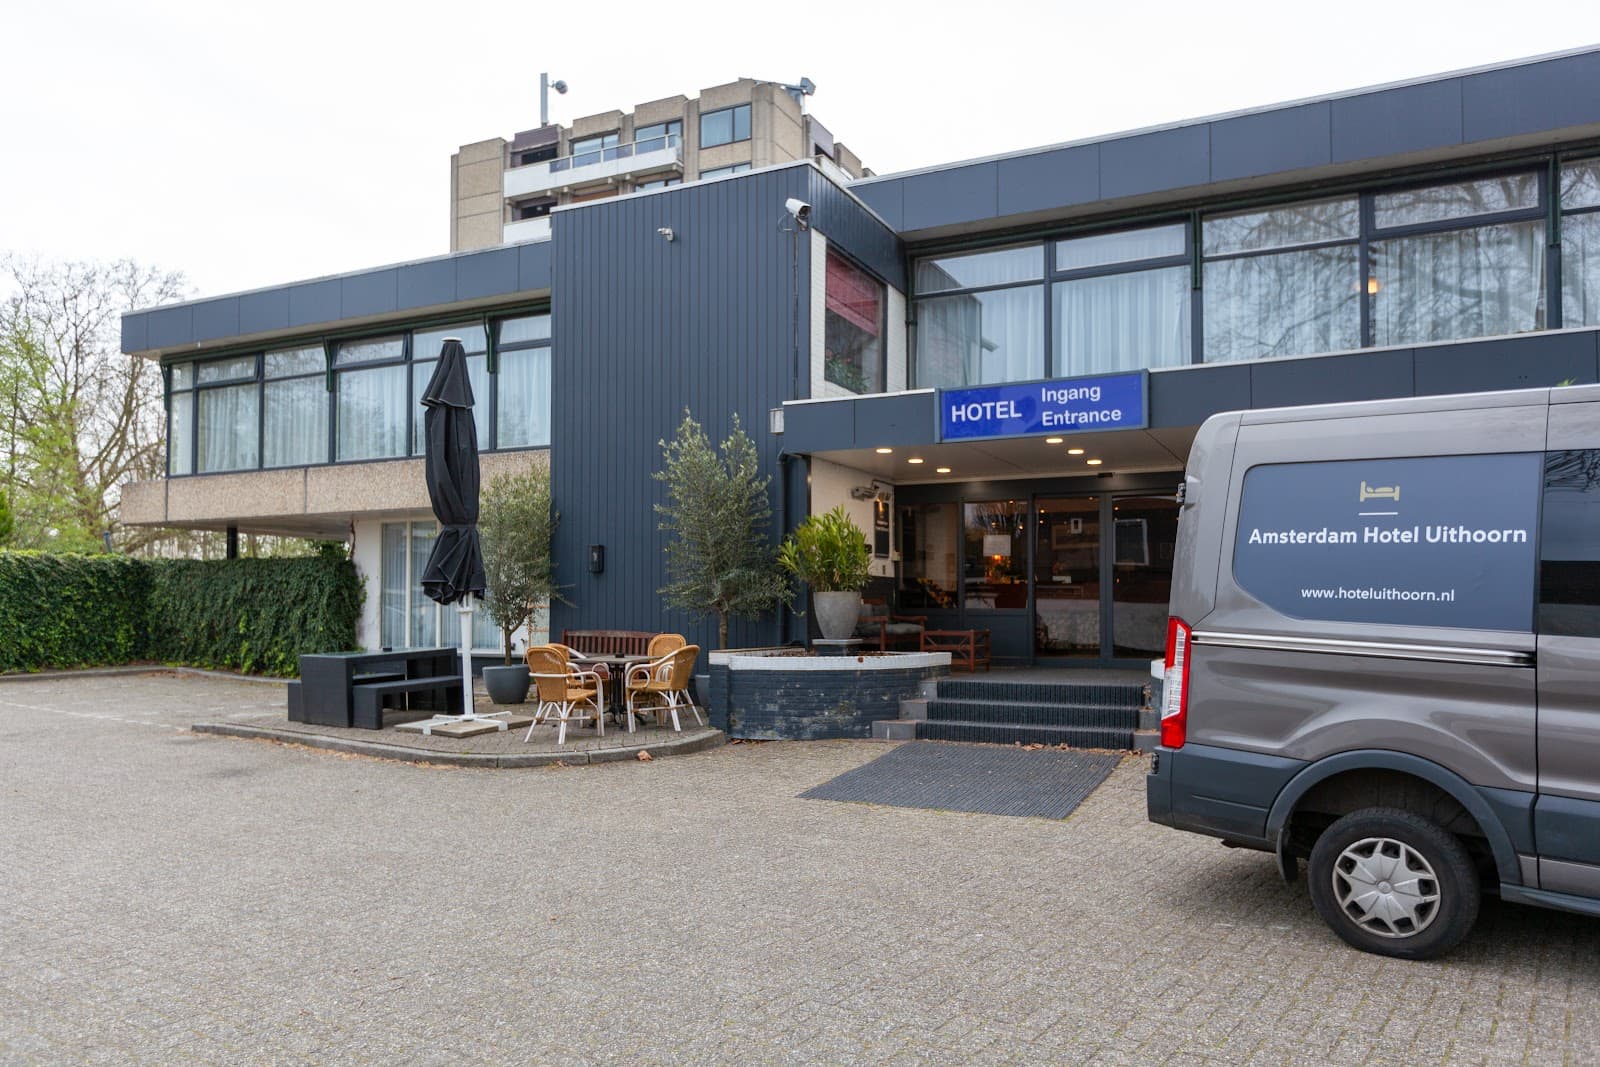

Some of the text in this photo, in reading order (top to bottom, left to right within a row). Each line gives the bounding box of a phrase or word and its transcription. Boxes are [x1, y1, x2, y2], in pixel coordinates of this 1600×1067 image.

[1041, 387, 1101, 404] Ingang
[951, 400, 1022, 422] HOTEL
[1042, 409, 1122, 426] Entrance
[1248, 526, 1527, 544] Amsterdam Hotel Uithoorn
[1301, 587, 1455, 602] www.hoteluithoorn.nl
